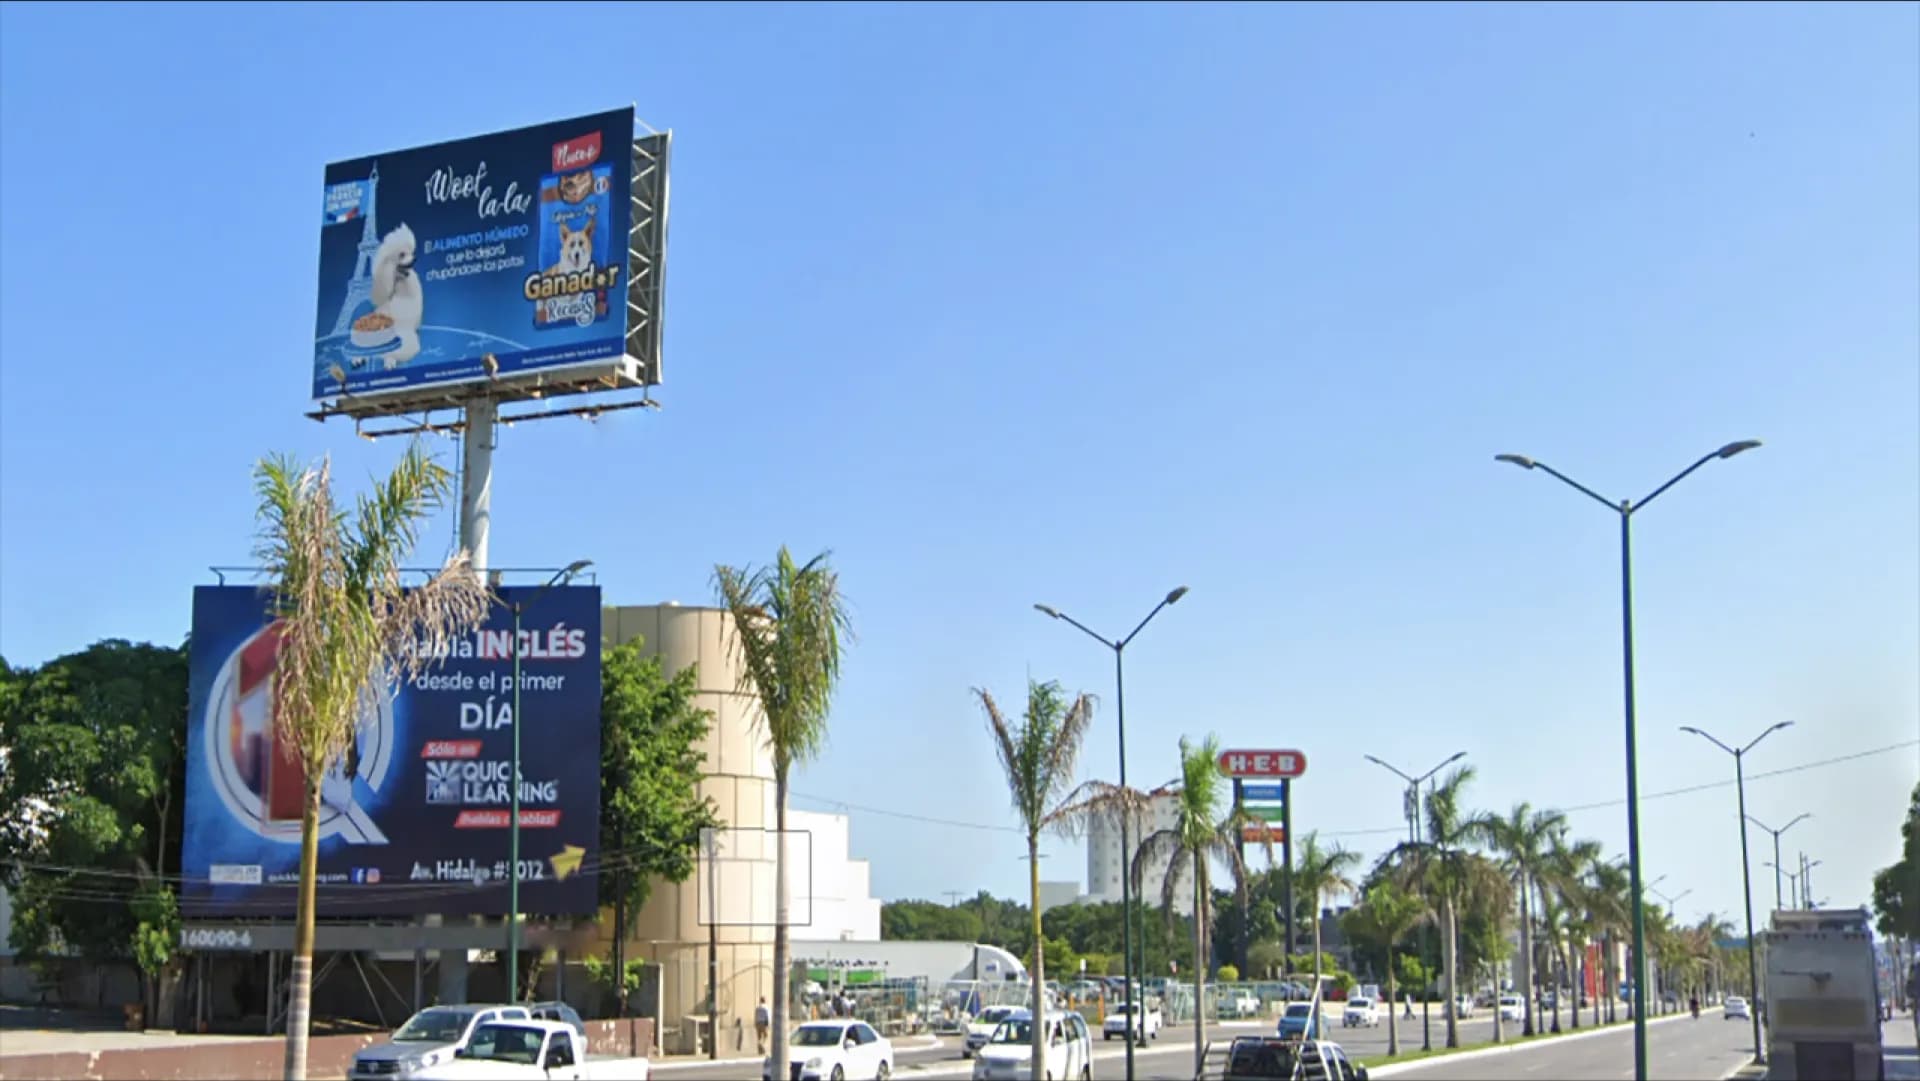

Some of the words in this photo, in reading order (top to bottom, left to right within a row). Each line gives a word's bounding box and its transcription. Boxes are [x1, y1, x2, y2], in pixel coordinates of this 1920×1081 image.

[433, 232, 482, 251] ALIMENTO
[446, 252, 465, 265] que
[476, 622, 586, 658] INGLÉS
[416, 671, 474, 690] desde
[479, 671, 495, 690] el
[460, 695, 514, 730] DÍA
[514, 813, 556, 825] ablas!
[268, 872, 348, 883] quickleng.com
[410, 861, 434, 880] Av.
[436, 858, 490, 886] Hidalgo
[180, 930, 251, 947] 160090-6
